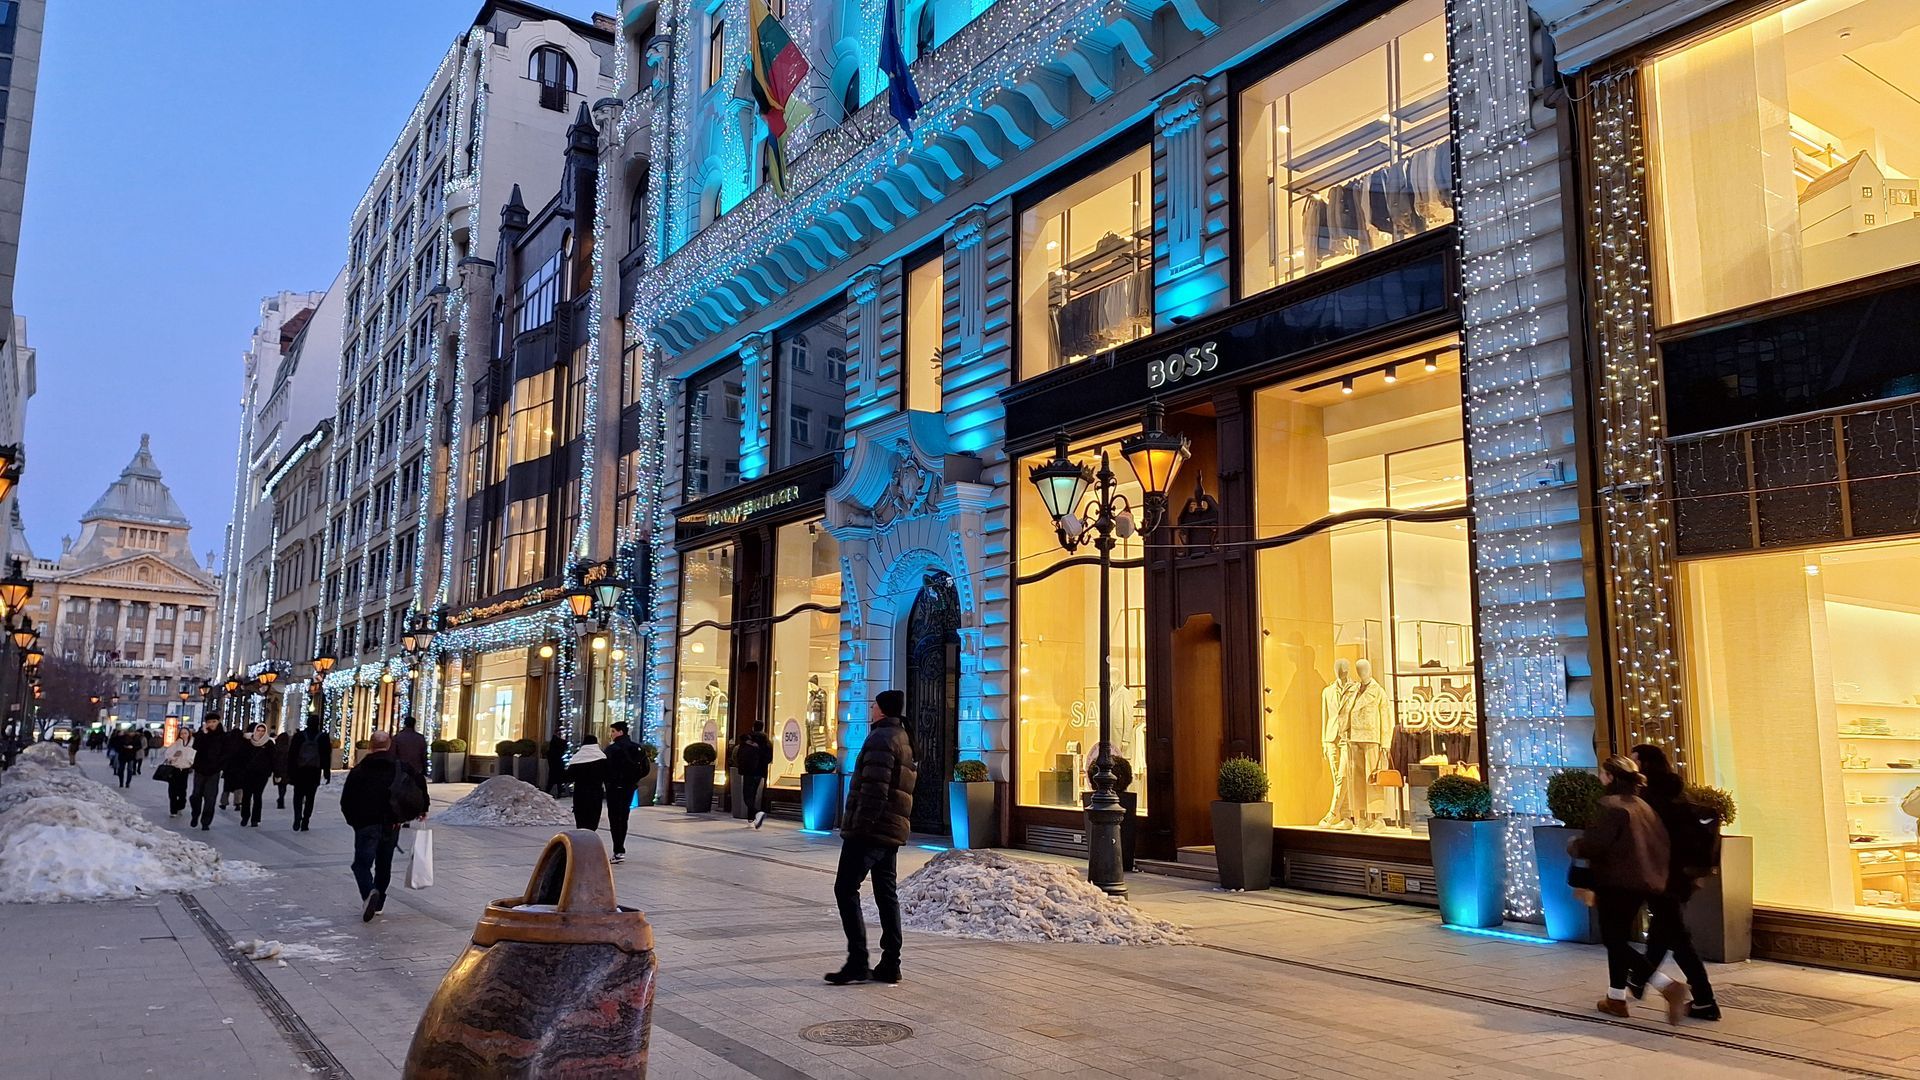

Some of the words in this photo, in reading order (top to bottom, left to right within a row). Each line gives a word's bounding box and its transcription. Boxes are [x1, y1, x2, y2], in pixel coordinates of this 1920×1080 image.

[1147, 341, 1219, 389] BOSS
[1398, 691, 1478, 729] BOS
[784, 731, 799, 743] 50%
